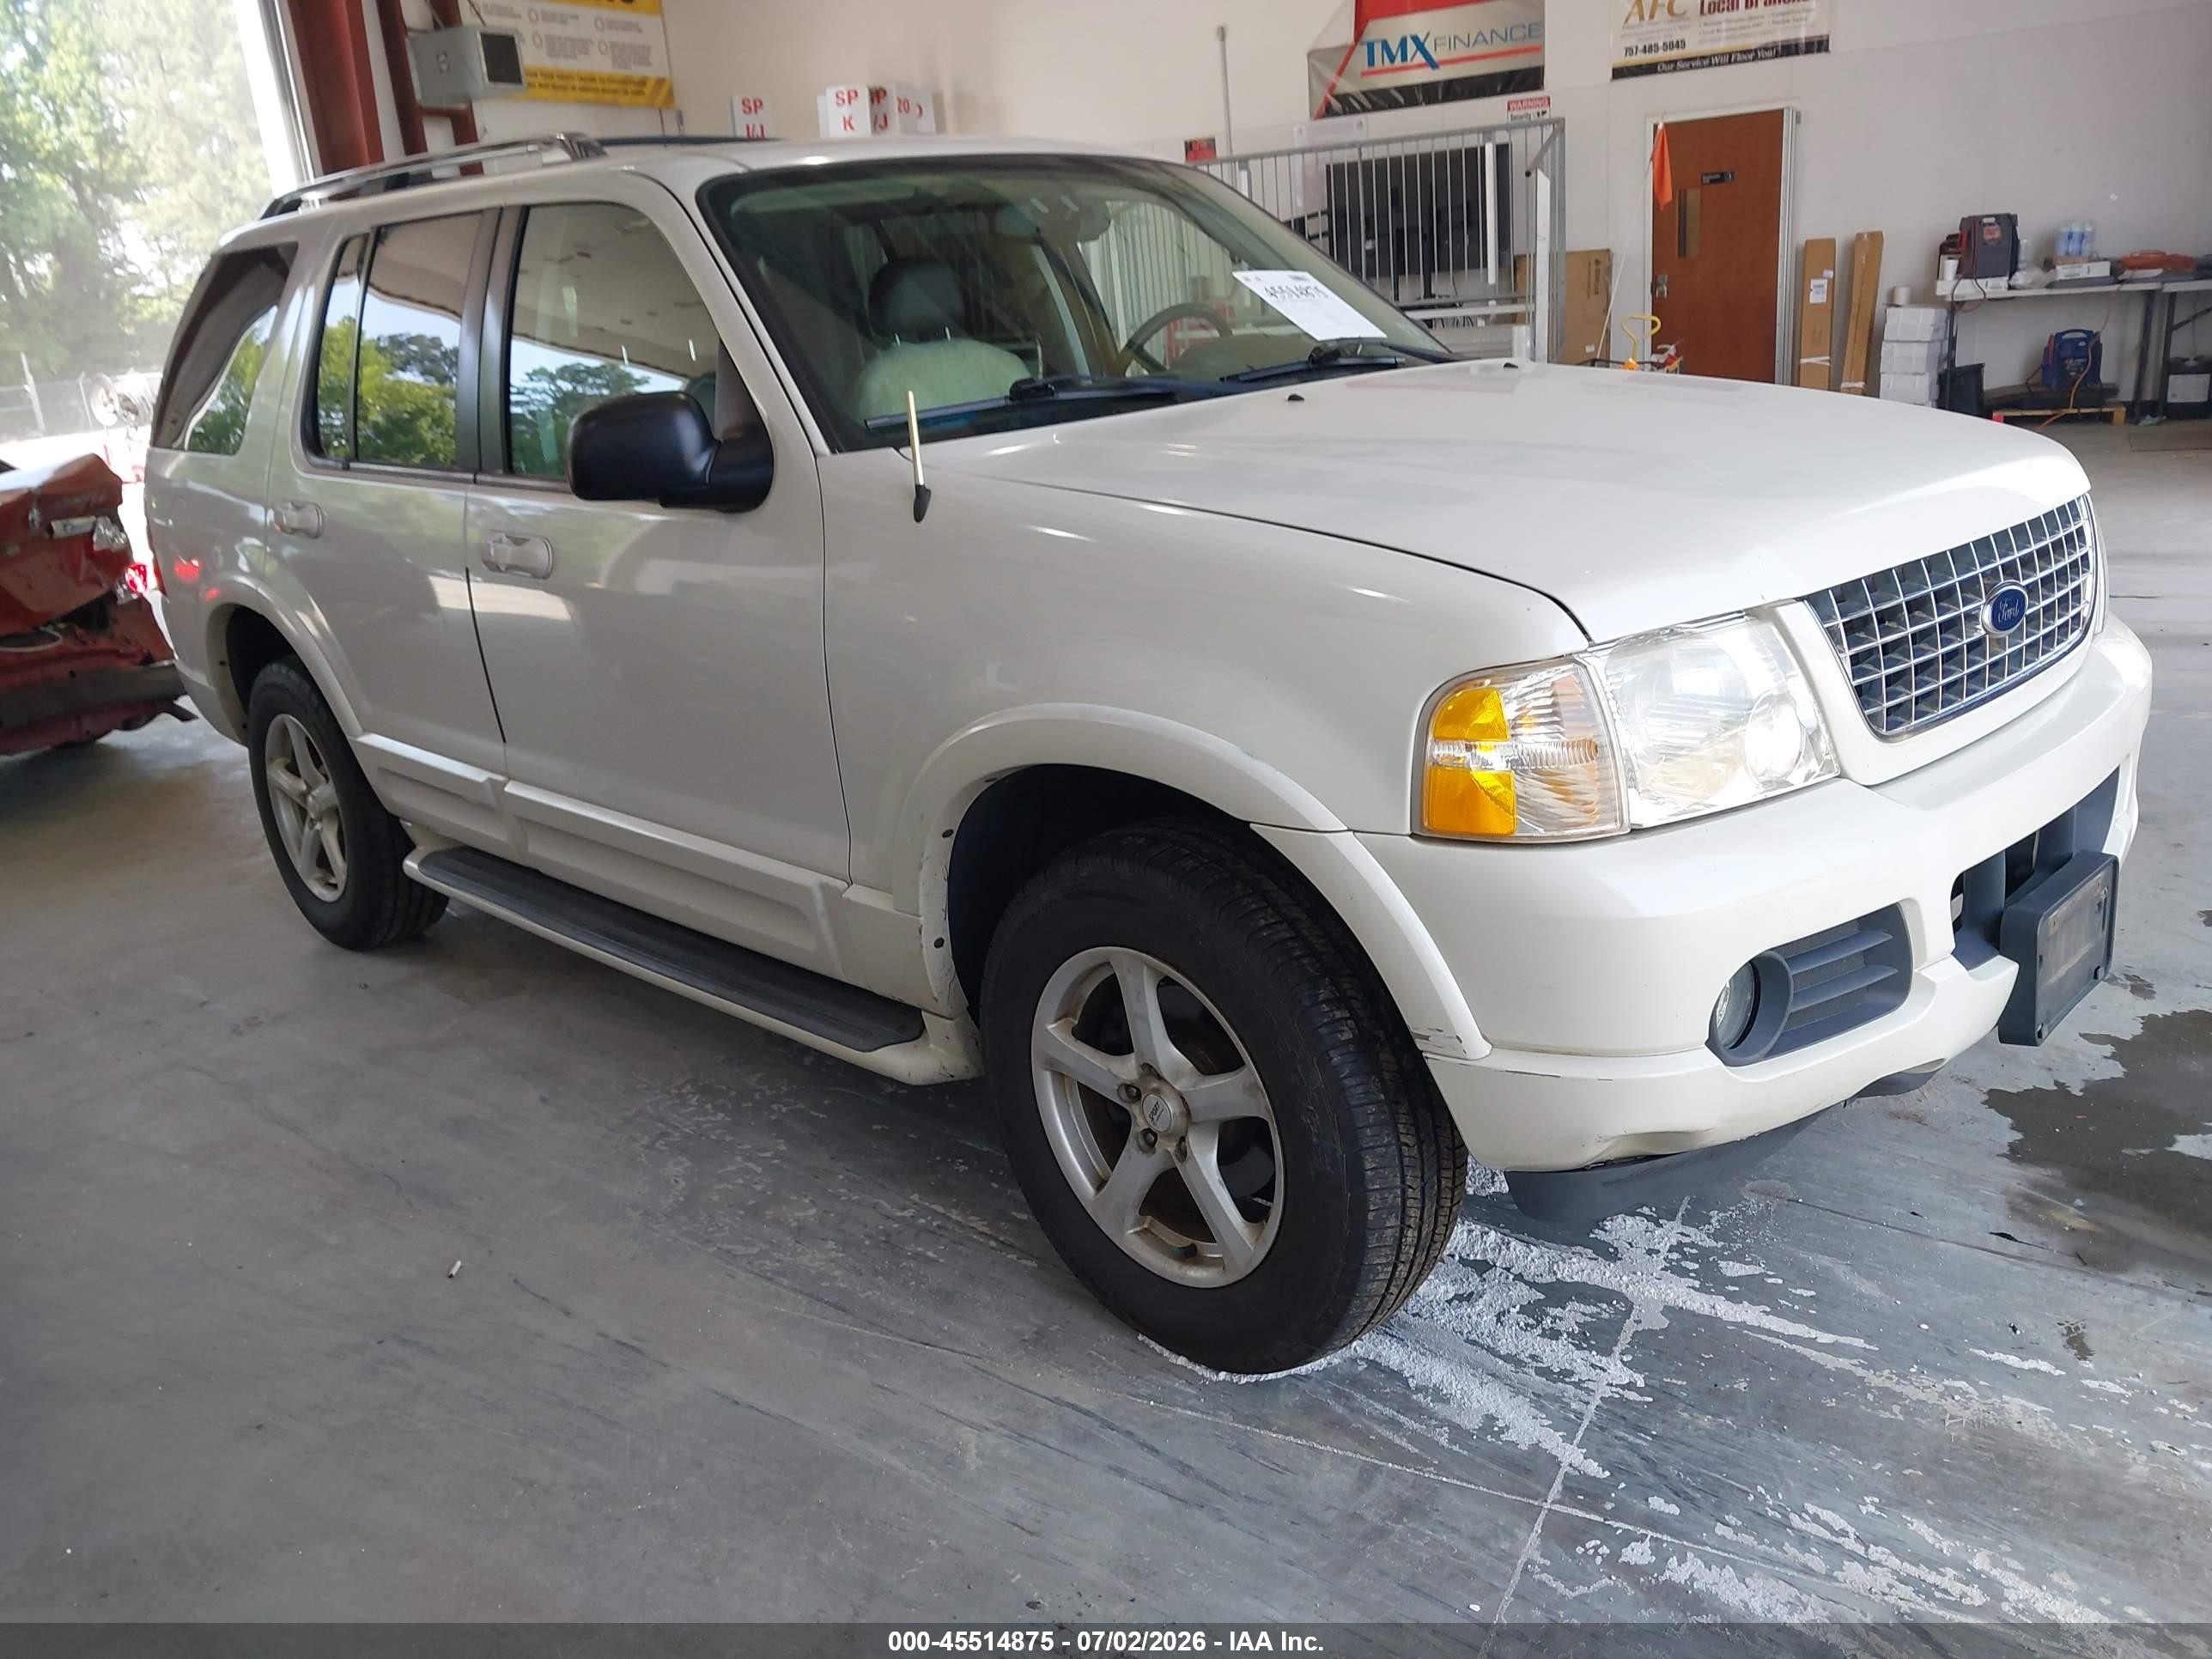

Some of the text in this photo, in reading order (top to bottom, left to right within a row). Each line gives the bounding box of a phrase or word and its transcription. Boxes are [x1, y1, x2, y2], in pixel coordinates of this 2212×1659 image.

[1622, 0, 1688, 28] AFC
[1360, 21, 1542, 70] TMX FINANCE
[1656, 62, 1675, 73] Our
[1711, 52, 1729, 66] Will
[1731, 51, 1755, 64] Floor
[742, 97, 763, 115] SP
[836, 88, 858, 106] SP
[870, 87, 887, 105] P
[842, 116, 855, 131] K
[1997, 599, 2020, 624] Ford
